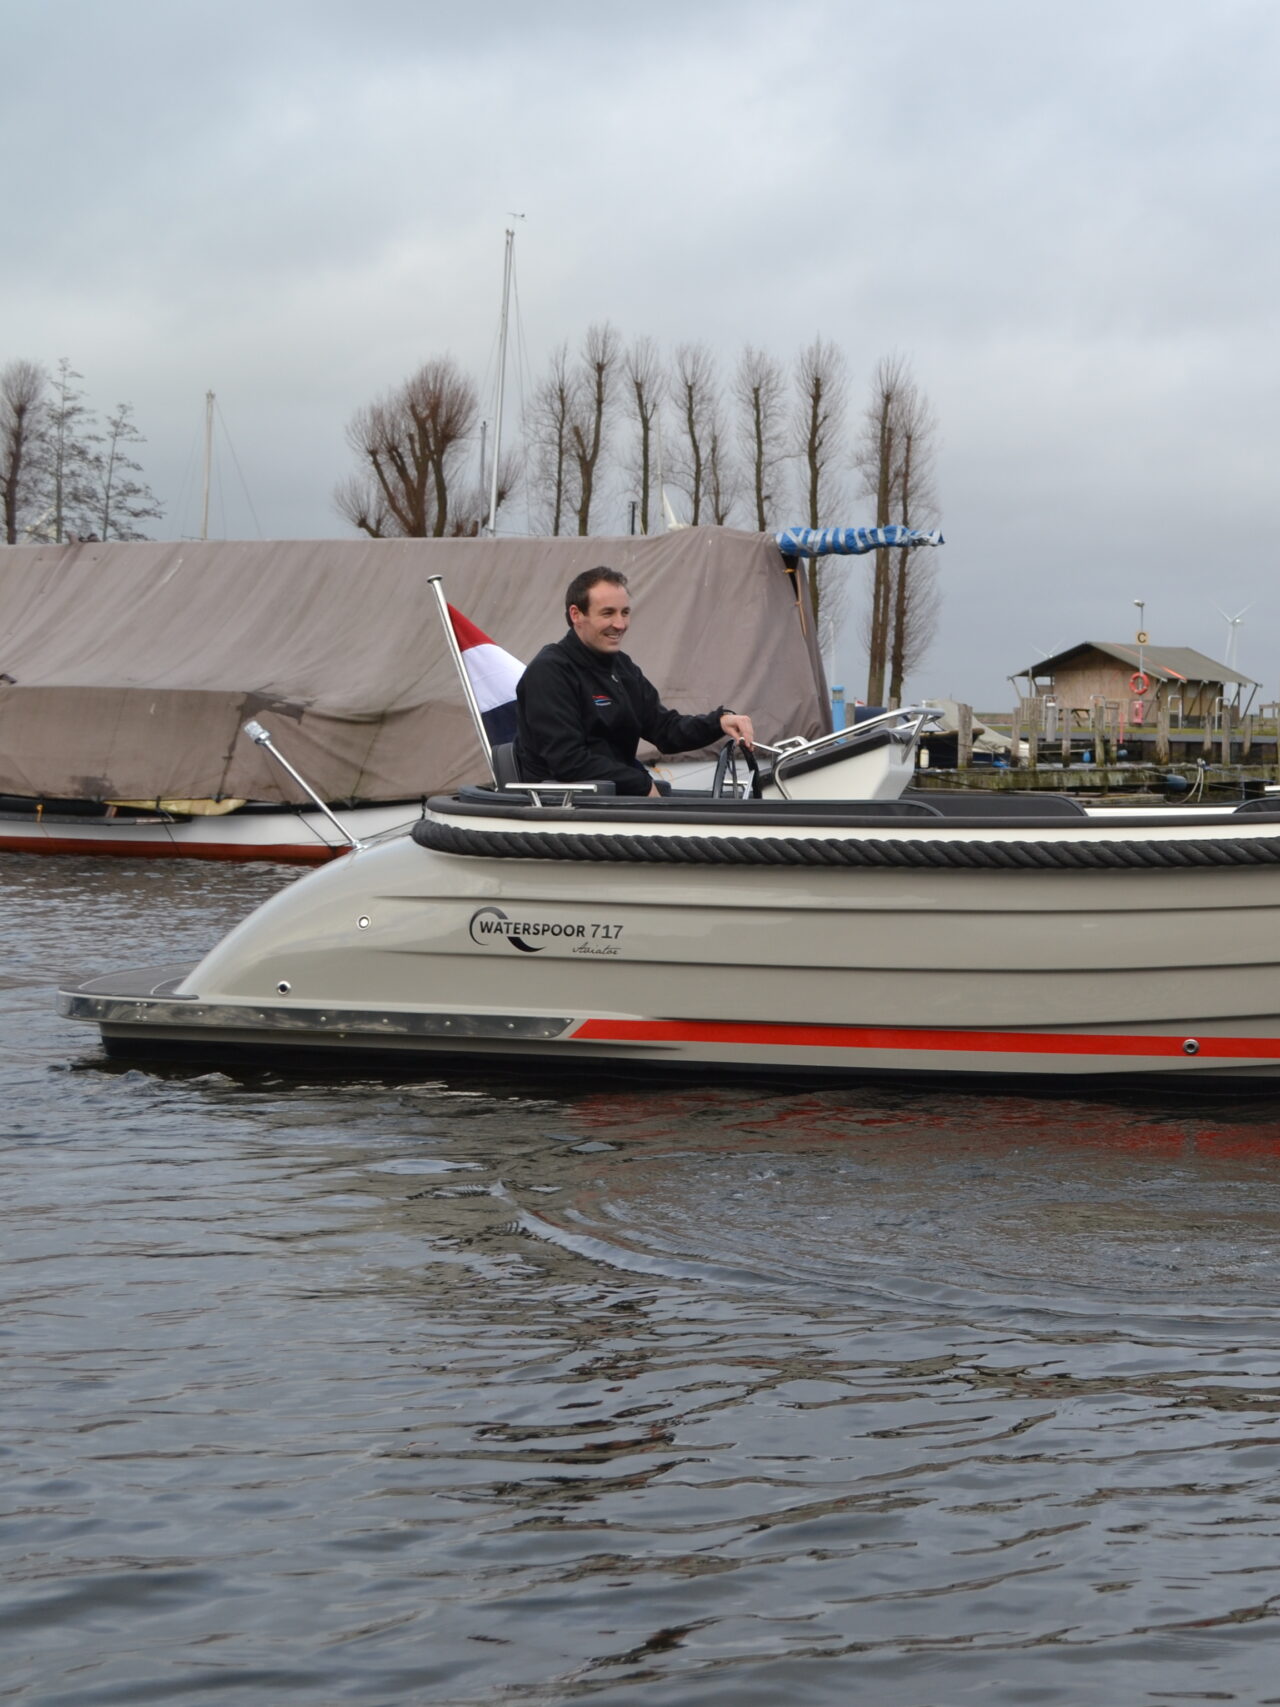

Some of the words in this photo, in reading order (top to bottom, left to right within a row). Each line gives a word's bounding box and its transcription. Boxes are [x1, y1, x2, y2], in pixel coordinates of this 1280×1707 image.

[1137, 632, 1147, 644] C
[479, 920, 585, 937] WATERSPOOR
[591, 924, 624, 939] 717
